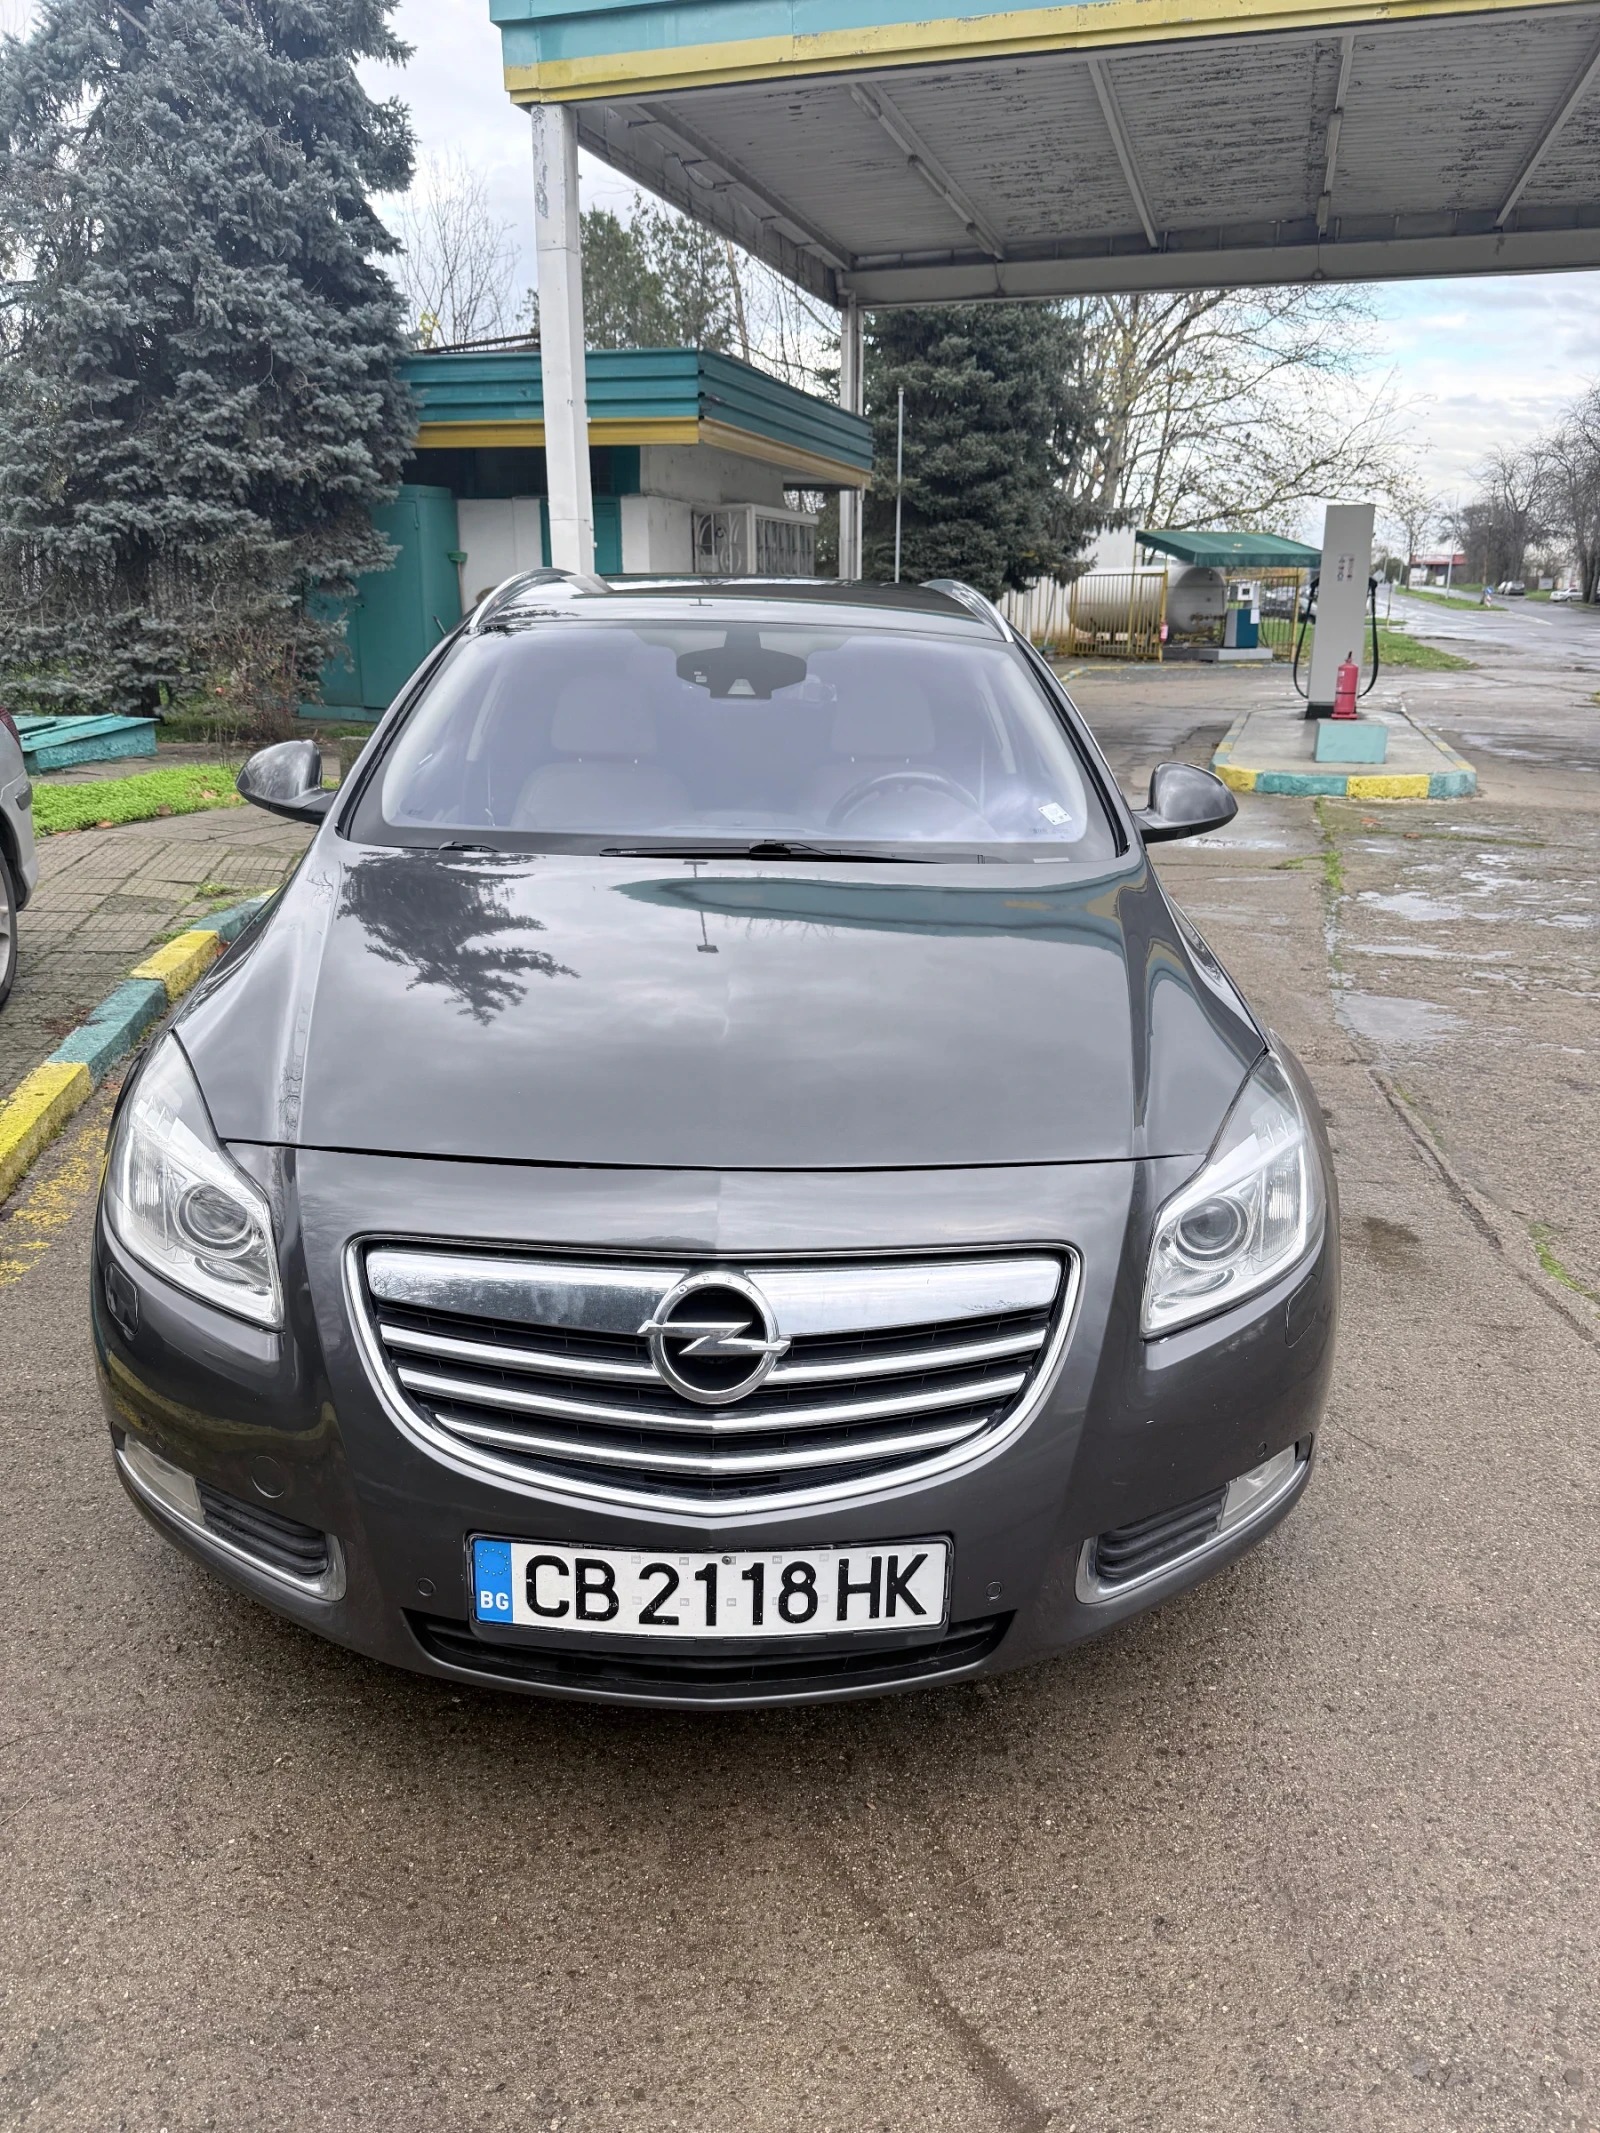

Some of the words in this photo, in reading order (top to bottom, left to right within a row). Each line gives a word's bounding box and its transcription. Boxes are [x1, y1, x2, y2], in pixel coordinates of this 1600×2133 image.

[678, 1275, 753, 1295] OPEL
[480, 1590, 509, 1610] BG
[638, 1562, 819, 1626] 2118
